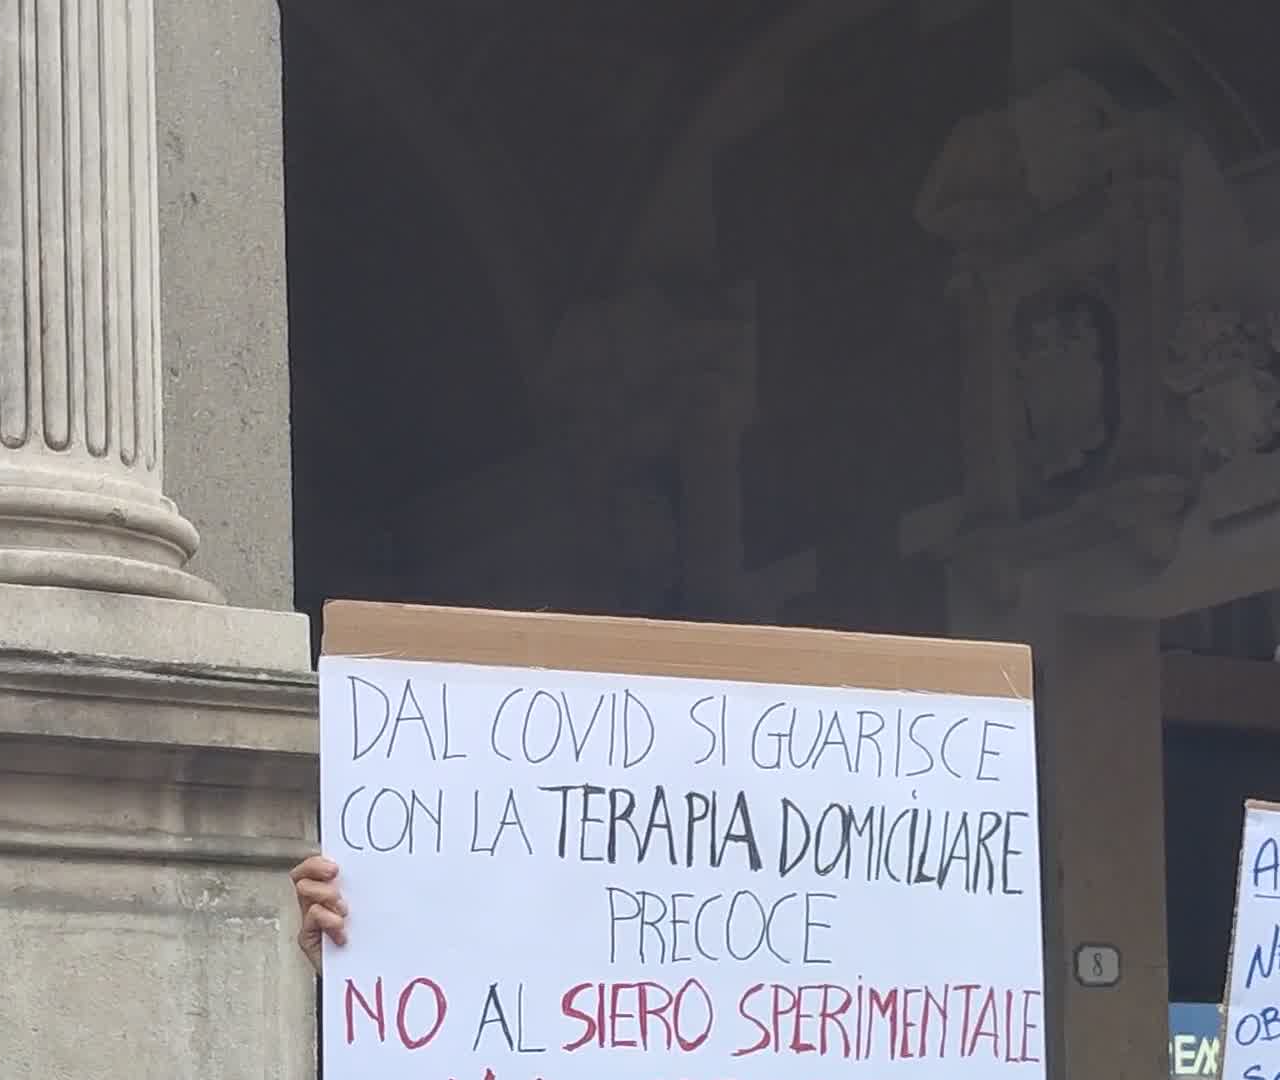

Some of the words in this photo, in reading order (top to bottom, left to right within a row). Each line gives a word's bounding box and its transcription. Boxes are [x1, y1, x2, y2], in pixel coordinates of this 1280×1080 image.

[348, 676, 466, 760] DAL
[492, 688, 654, 768] COVID
[690, 696, 726, 765] SI
[752, 703, 1015, 781] GUARISCE
[341, 787, 442, 854] CON
[471, 789, 532, 856] LA
[538, 783, 762, 872] TERAPIA
[779, 790, 1028, 894] DOMICILIARE
[606, 887, 836, 964] PRECOCE
[1092, 952, 1104, 977] 8
[345, 977, 447, 1049] NO
[473, 983, 546, 1052] AL
[562, 978, 713, 1051] SIERO
[732, 975, 1040, 1062] SPERIMENTALE
